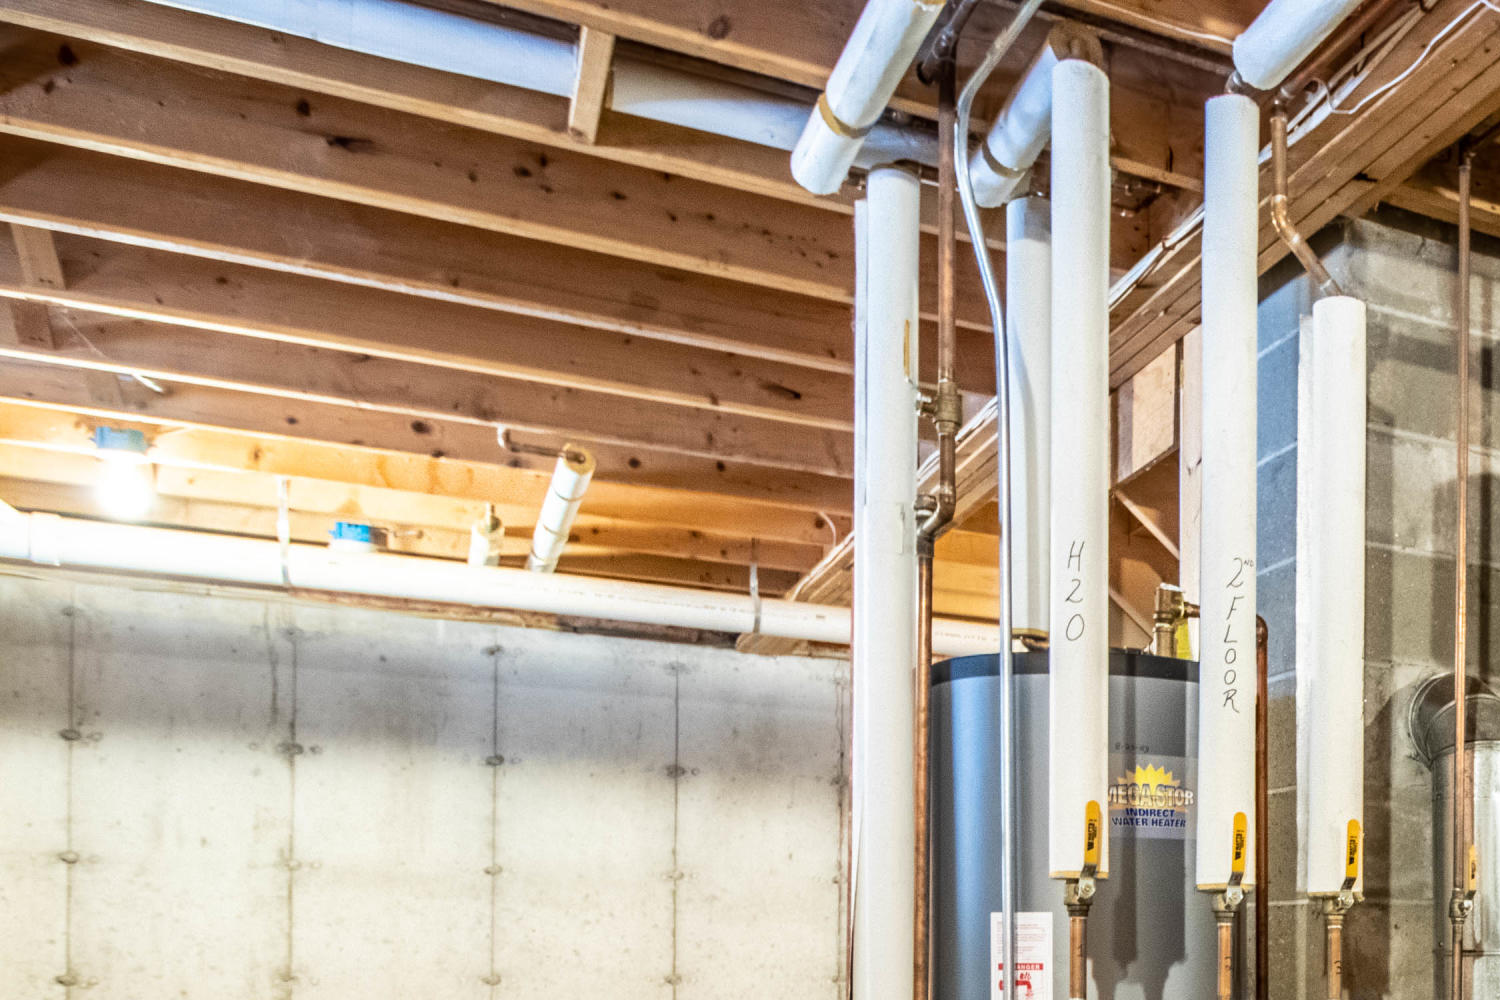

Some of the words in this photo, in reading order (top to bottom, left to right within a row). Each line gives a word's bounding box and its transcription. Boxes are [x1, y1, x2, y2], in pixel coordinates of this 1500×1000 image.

[1223, 596, 1245, 714] FLOOR
[1126, 808, 1175, 817] INDIRECT
[1112, 817, 1148, 826] WATER
[1151, 819, 1186, 828] HEATER
[1013, 963, 1041, 971] ANGER
